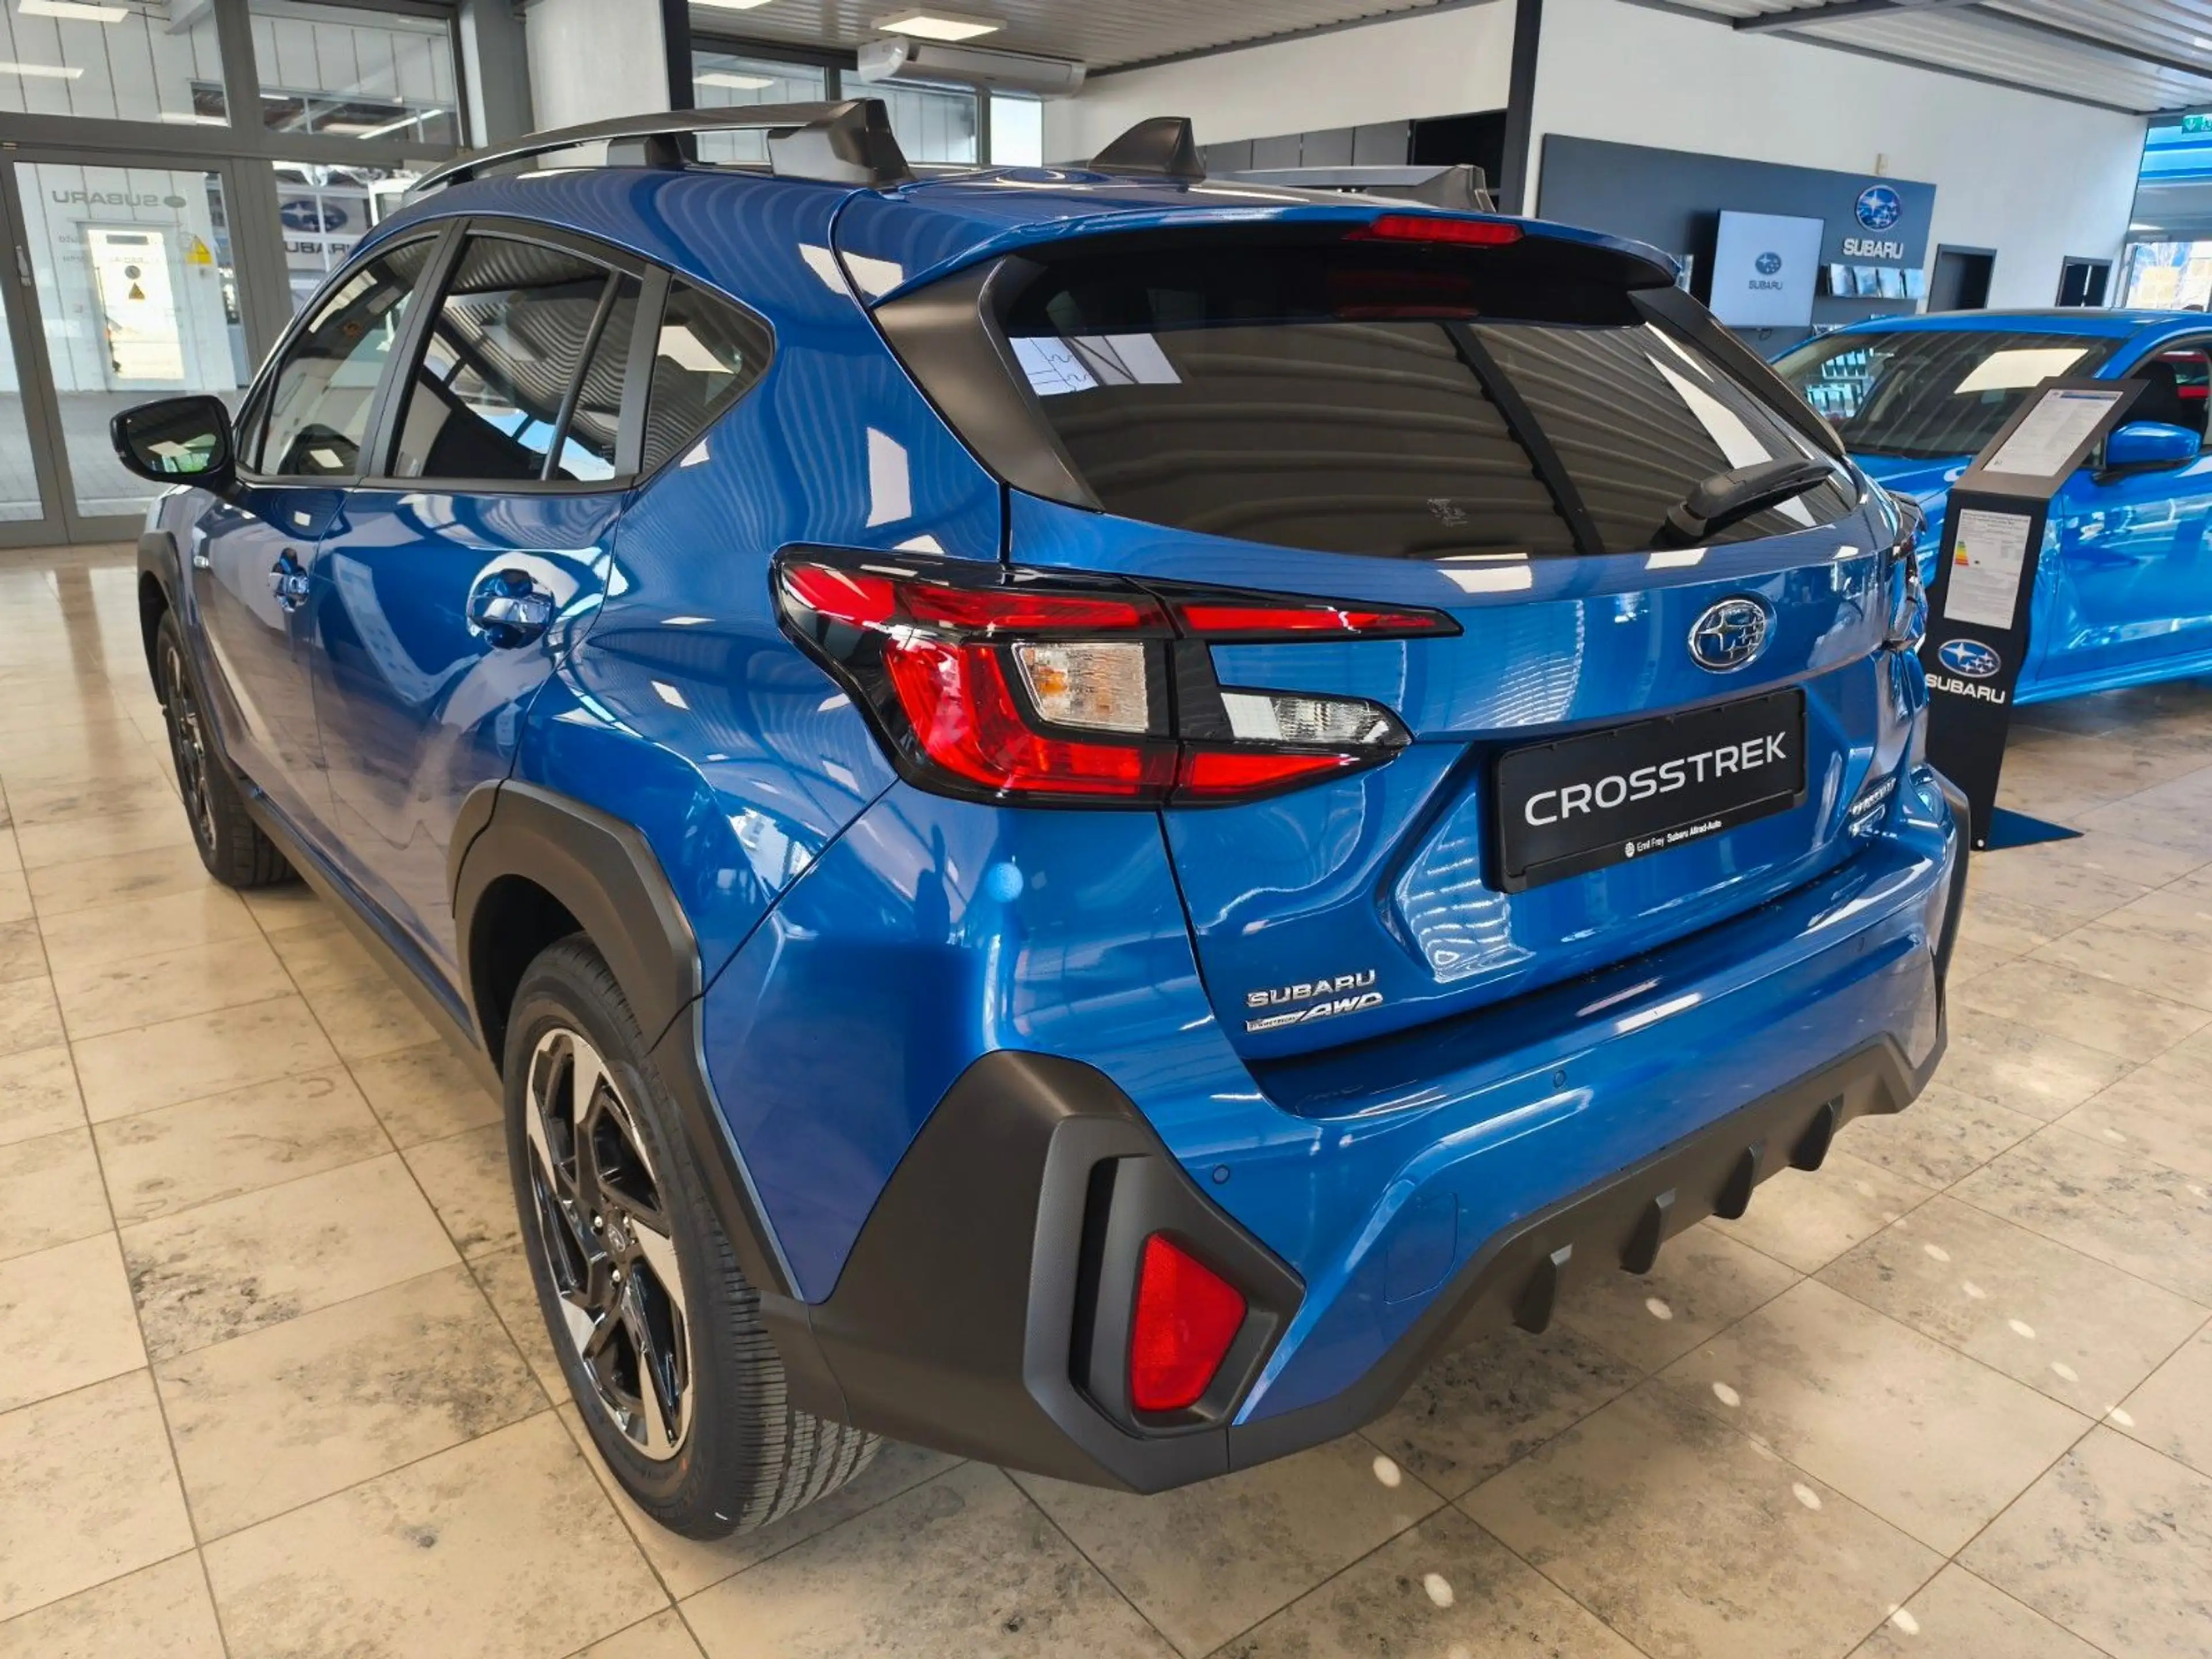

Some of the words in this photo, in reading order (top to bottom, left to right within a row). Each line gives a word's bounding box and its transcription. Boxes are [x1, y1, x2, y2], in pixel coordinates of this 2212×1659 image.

[1843, 238, 1903, 259] SUBARU
[1749, 280, 1783, 290] SUBARU
[1925, 673, 2006, 704] SUBARU
[1524, 731, 1786, 827] CROSSTREK
[1651, 837, 1665, 849] Frey
[1666, 830, 1689, 843] Subaru
[1247, 969, 1376, 1007] SUBARU
[1300, 991, 1384, 1021] AWD
